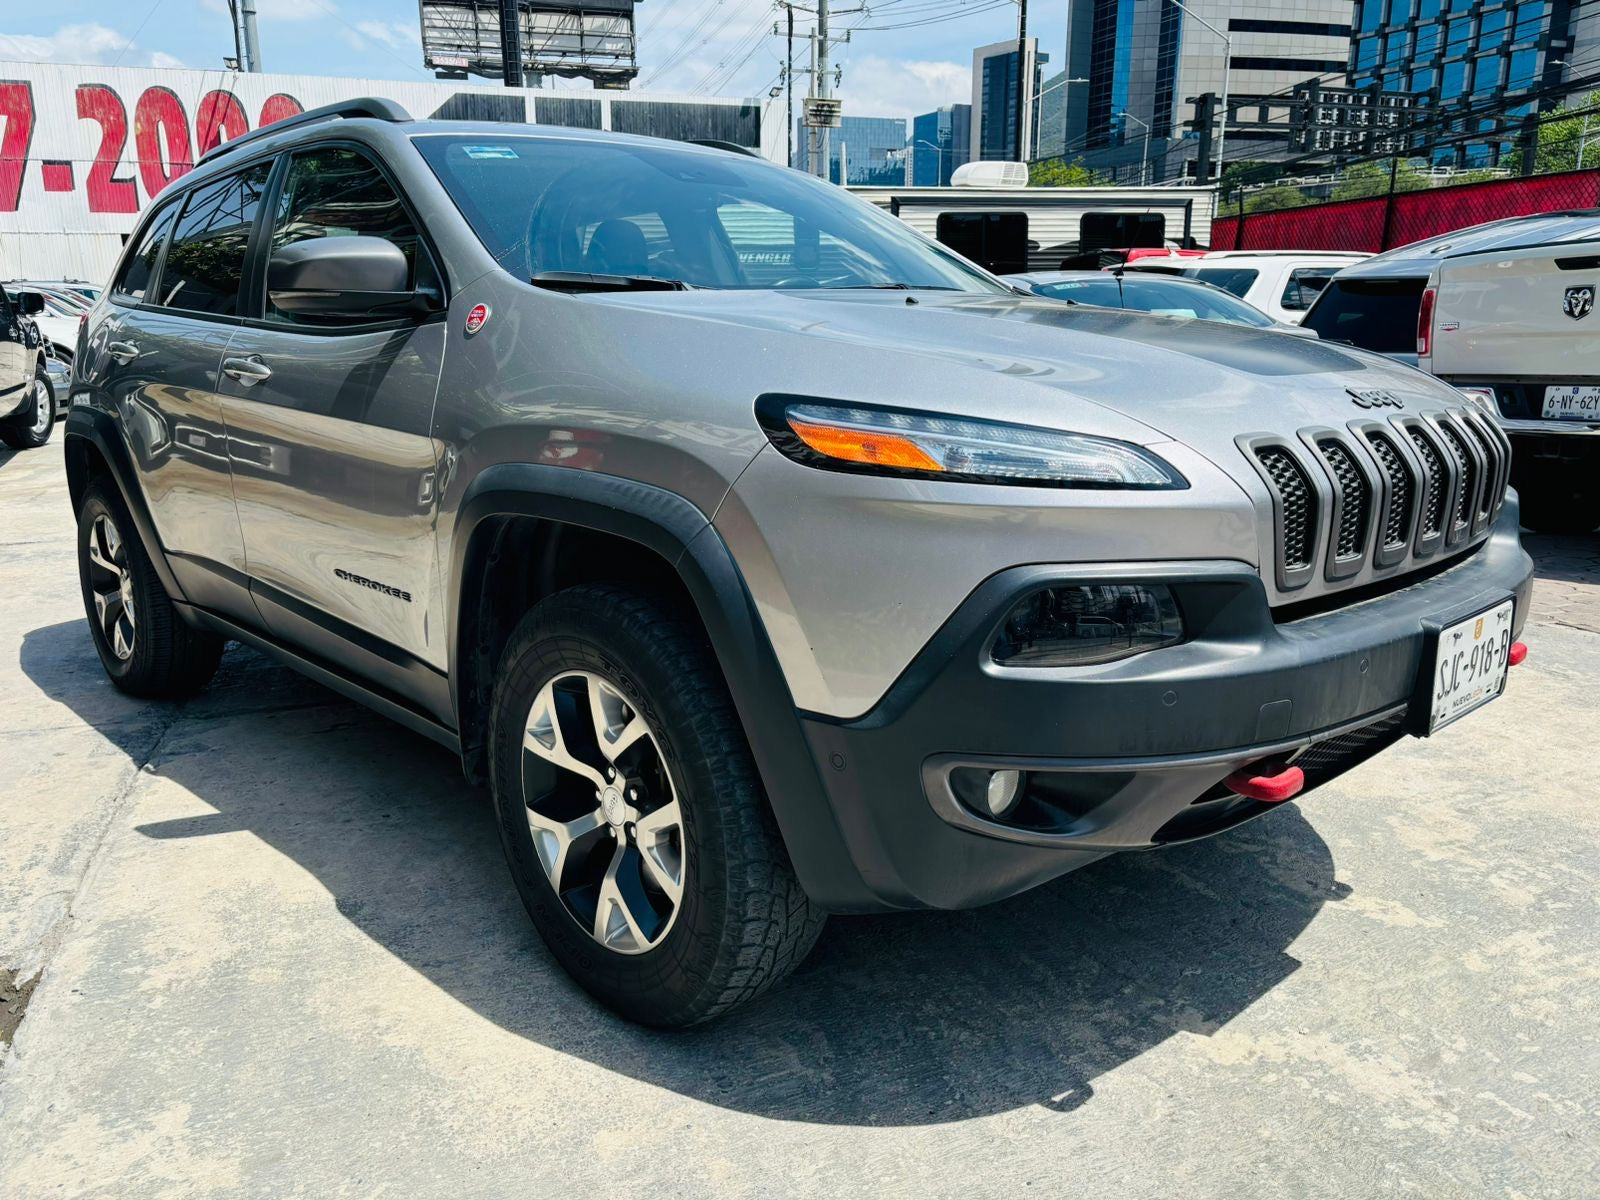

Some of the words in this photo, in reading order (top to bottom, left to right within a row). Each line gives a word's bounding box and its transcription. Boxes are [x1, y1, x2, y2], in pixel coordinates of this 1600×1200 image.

[0, 79, 306, 213] 7-20
[736, 252, 792, 264] VENGER
[1344, 386, 1405, 410] Jeep
[1548, 395, 1600, 410] 6-NY-62Y
[333, 568, 412, 603] CHEROKEE
[1437, 628, 1509, 701] SJC-918-B
